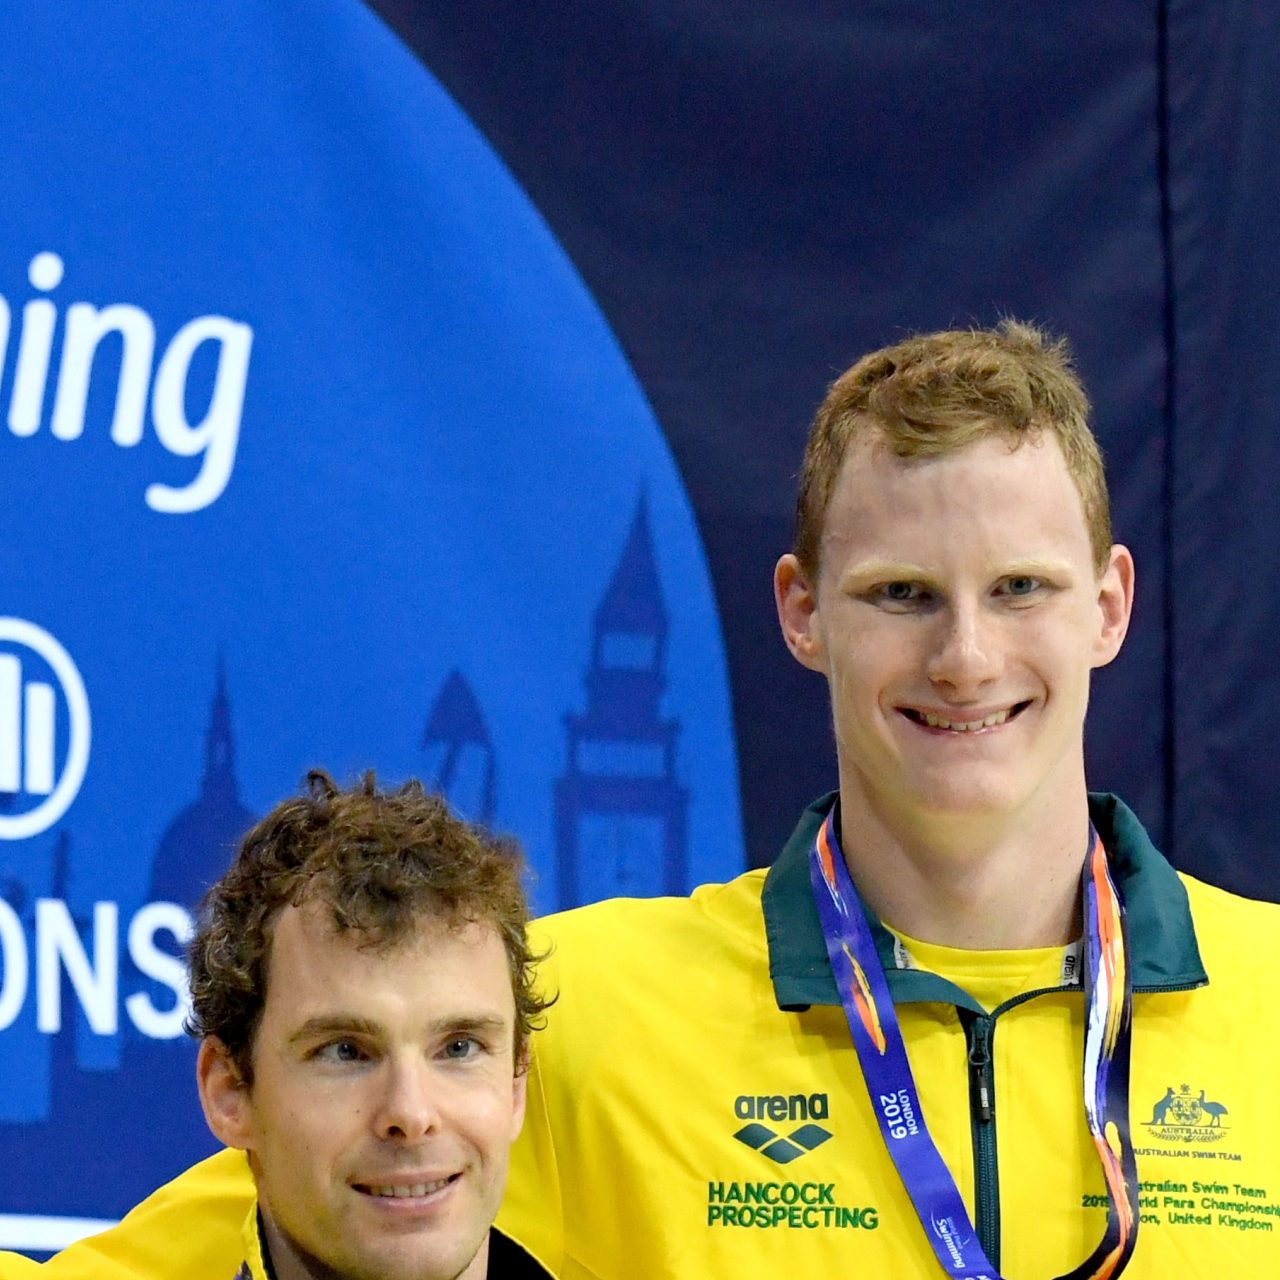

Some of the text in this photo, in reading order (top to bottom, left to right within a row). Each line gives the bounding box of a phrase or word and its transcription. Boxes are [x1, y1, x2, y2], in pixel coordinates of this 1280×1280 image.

[734, 1093, 829, 1122] arena
[880, 1093, 908, 1139] 2019
[898, 1089, 919, 1136] LONDON
[1161, 1127, 1215, 1136] AUSTRALIA
[1133, 1148, 1242, 1161] AUSTRALIAN SWIM TEAM
[708, 1181, 835, 1205] HANCOCK
[1138, 1180, 1266, 1199] stralian Swim Team
[1164, 1197, 1195, 1209] Para
[707, 1204, 879, 1230] PROSPECTING
[1169, 1212, 1211, 1225] United
[1218, 1214, 1273, 1232] Kingdom
[936, 1218, 966, 1269] Swimming
